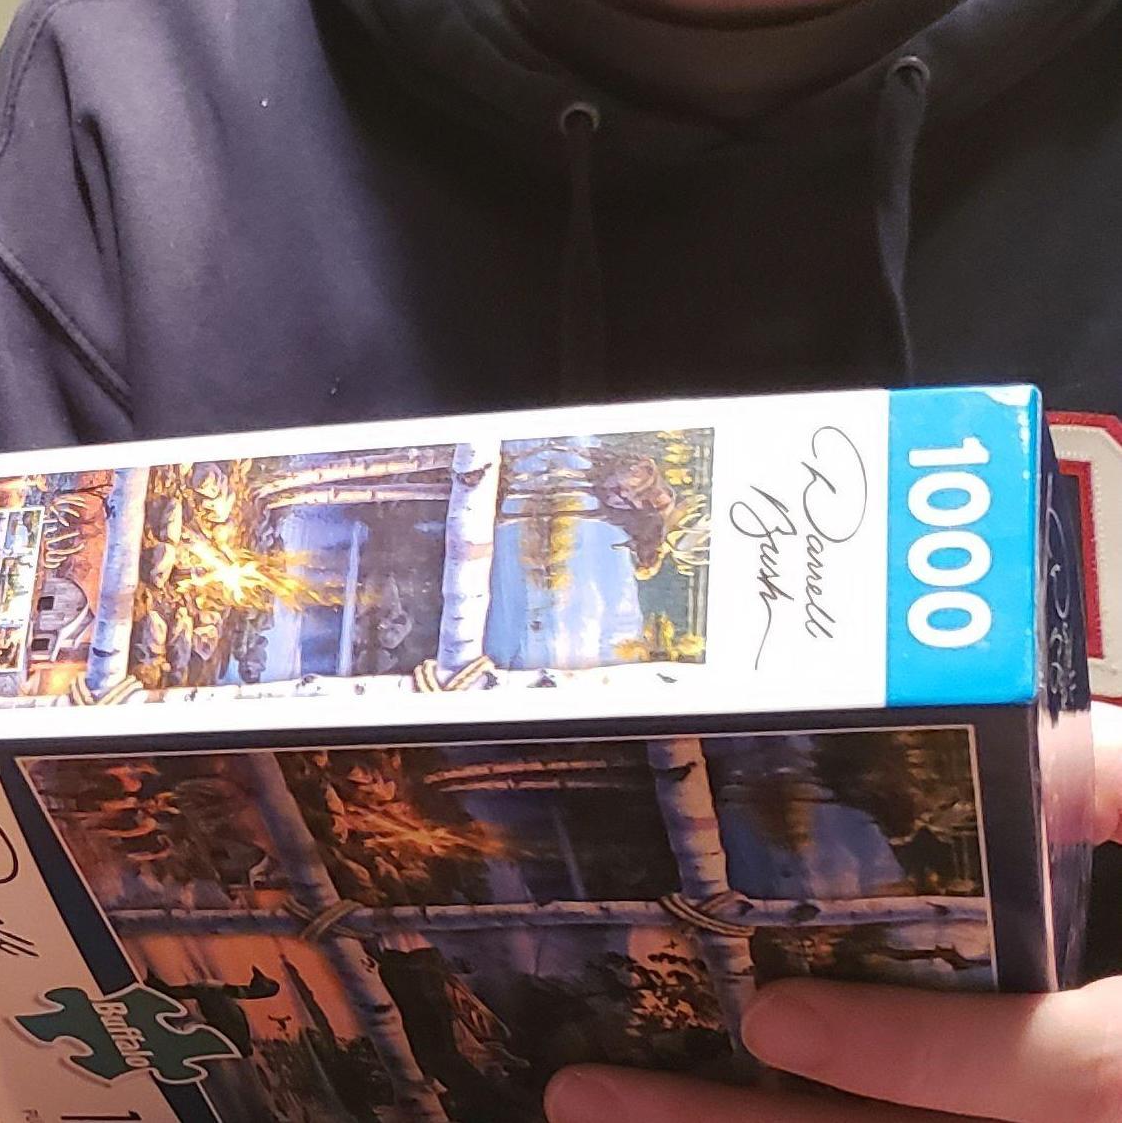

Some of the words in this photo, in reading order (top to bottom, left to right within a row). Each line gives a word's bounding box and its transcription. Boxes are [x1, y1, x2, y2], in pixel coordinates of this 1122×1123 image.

[729, 485, 797, 671] Bush
[802, 426, 868, 639] Darrell
[907, 436, 992, 649] 1000
[95, 1000, 147, 1069] Buffalo
